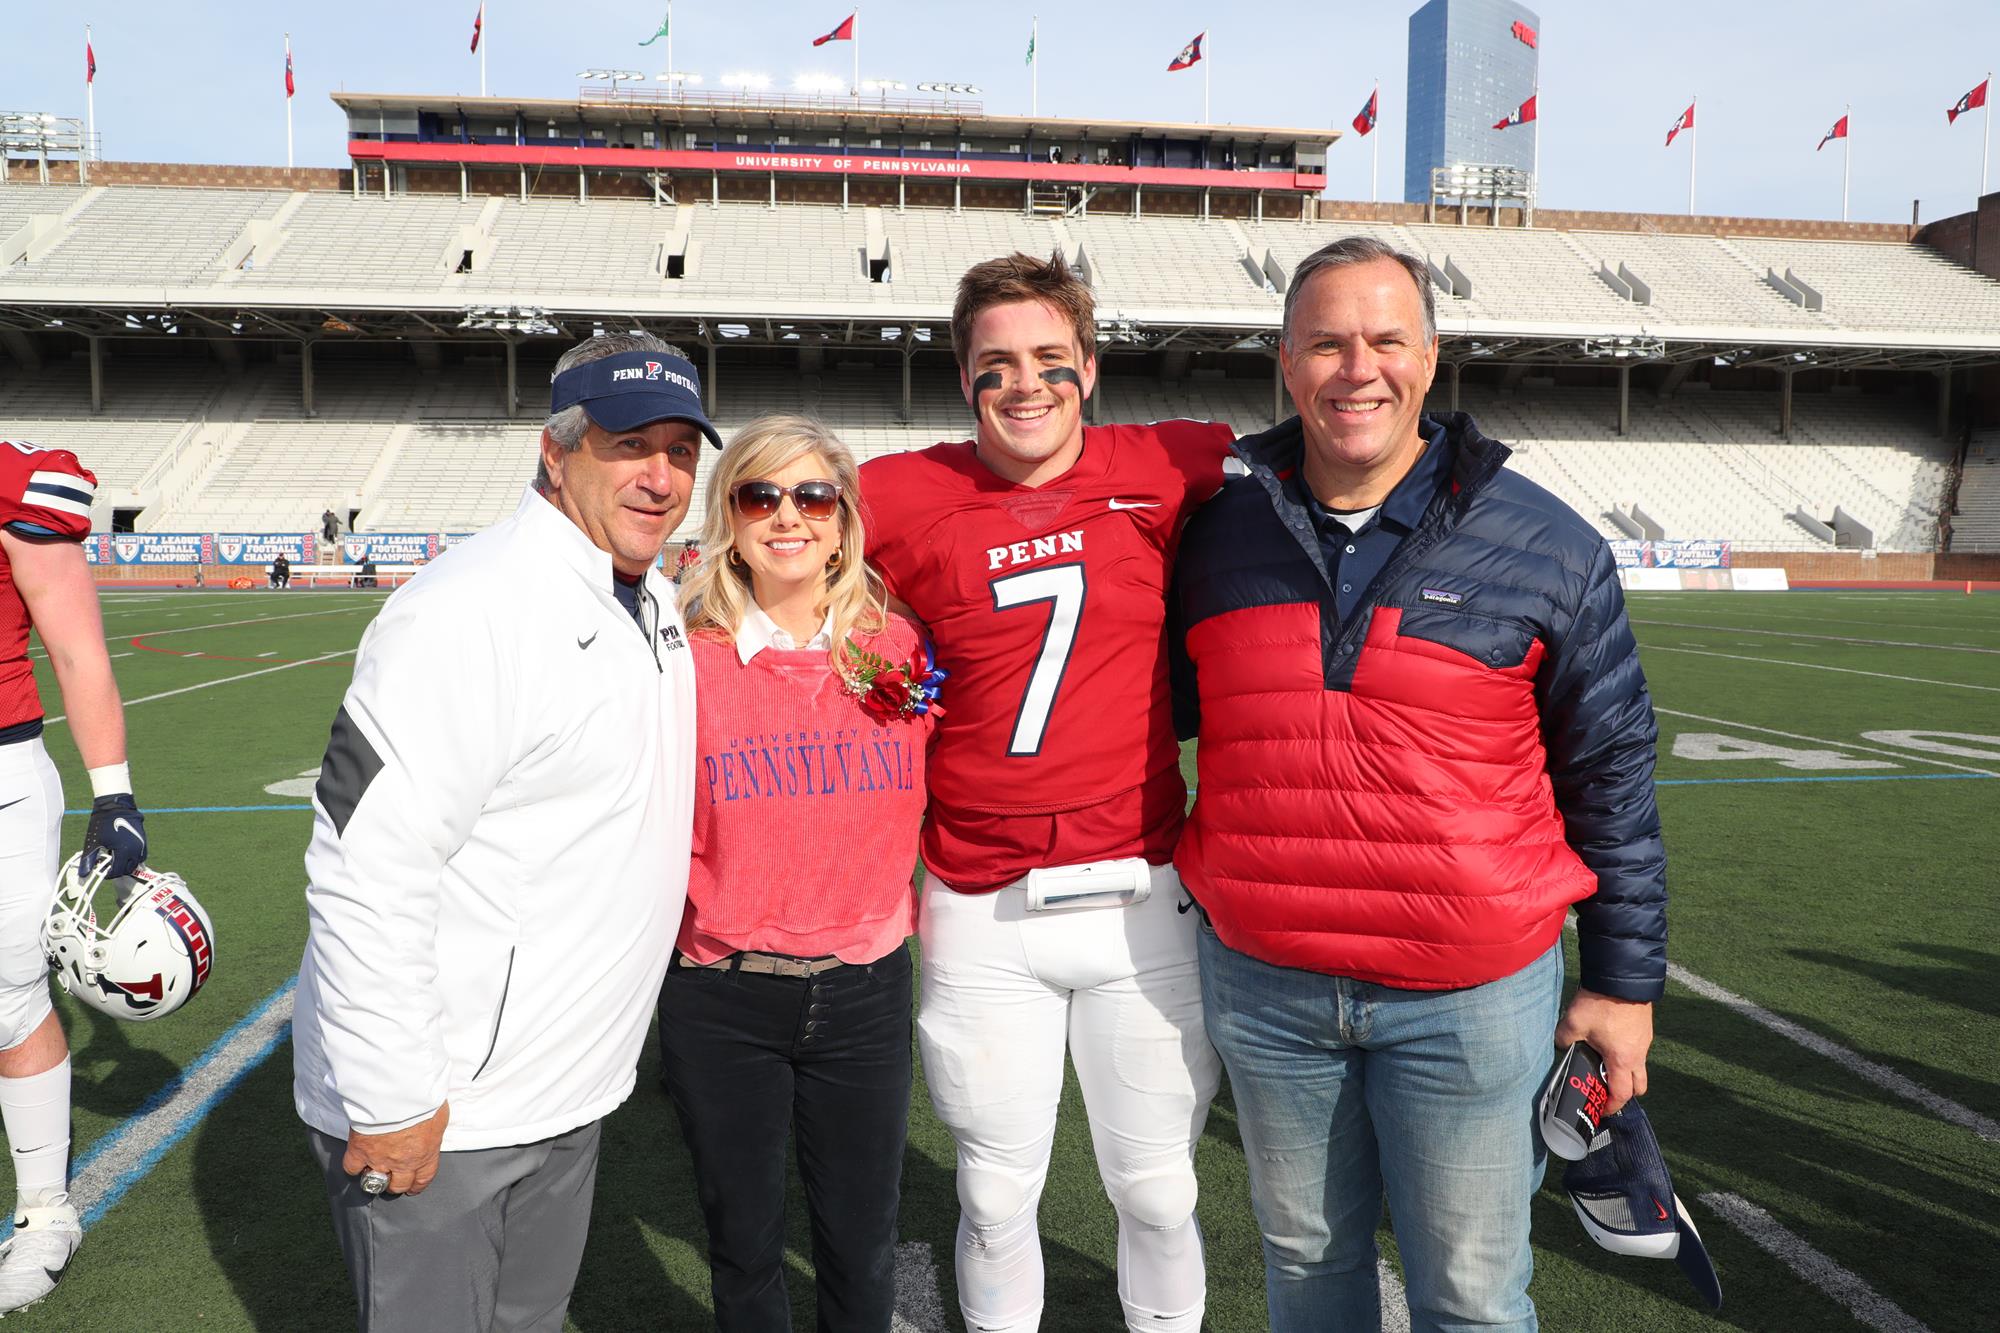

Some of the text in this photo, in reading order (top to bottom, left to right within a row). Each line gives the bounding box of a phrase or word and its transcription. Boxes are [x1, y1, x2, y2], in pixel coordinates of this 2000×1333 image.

[736, 156, 971, 173] UNIVERSITY OF PENNSYLVANIA
[613, 368, 643, 382] PENN
[664, 370, 699, 399] FOOTBA
[140, 536, 200, 544] IVY LEAGUE
[243, 536, 302, 544] IVY LEAGUE
[368, 536, 427, 544] IVY LEAGUE
[427, 534, 439, 559] 993
[144, 545, 196, 553] FOOTBALL
[246, 545, 298, 553] FOOTBALL
[371, 545, 422, 553] FOOTBALL
[986, 530, 1084, 570] PENN
[141, 553, 199, 562] CHAMPIONS
[368, 553, 425, 562] CHAMPIONS
[988, 561, 1088, 757] 7
[731, 727, 893, 748] UNIVERSITY OF
[704, 740, 913, 804] PENNSYLVANIA
[151, 887, 173, 903] PENN
[1569, 1075, 1603, 1111] ZERO
[1586, 1072, 1609, 1104] GAR
